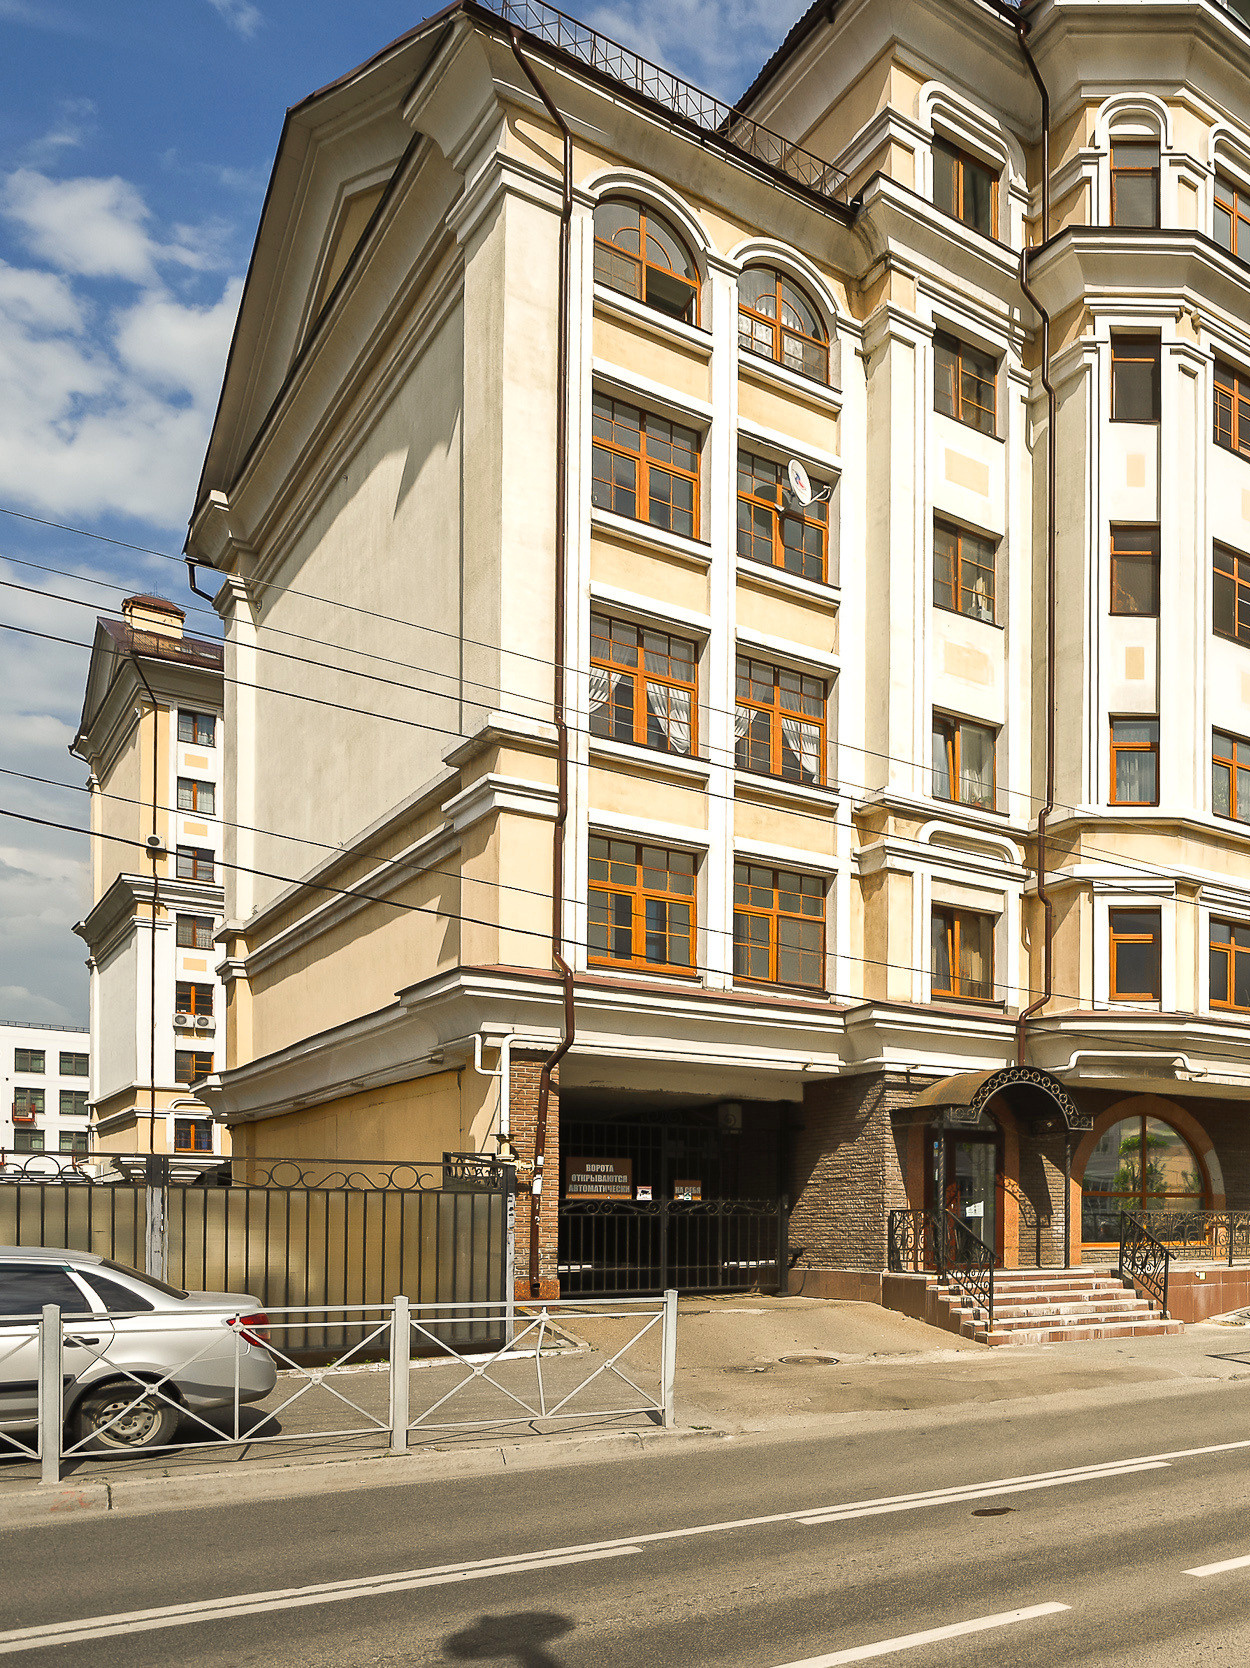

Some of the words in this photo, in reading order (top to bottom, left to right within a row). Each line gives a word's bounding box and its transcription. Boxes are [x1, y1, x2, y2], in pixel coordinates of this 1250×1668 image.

[585, 1163, 614, 1173] ВОРОТА
[571, 1174, 628, 1183] ОТКРЫВАЮТСЯ
[568, 1184, 631, 1193] АВТОМАТИЧЕСКИ
[674, 1186, 685, 1194] НА
